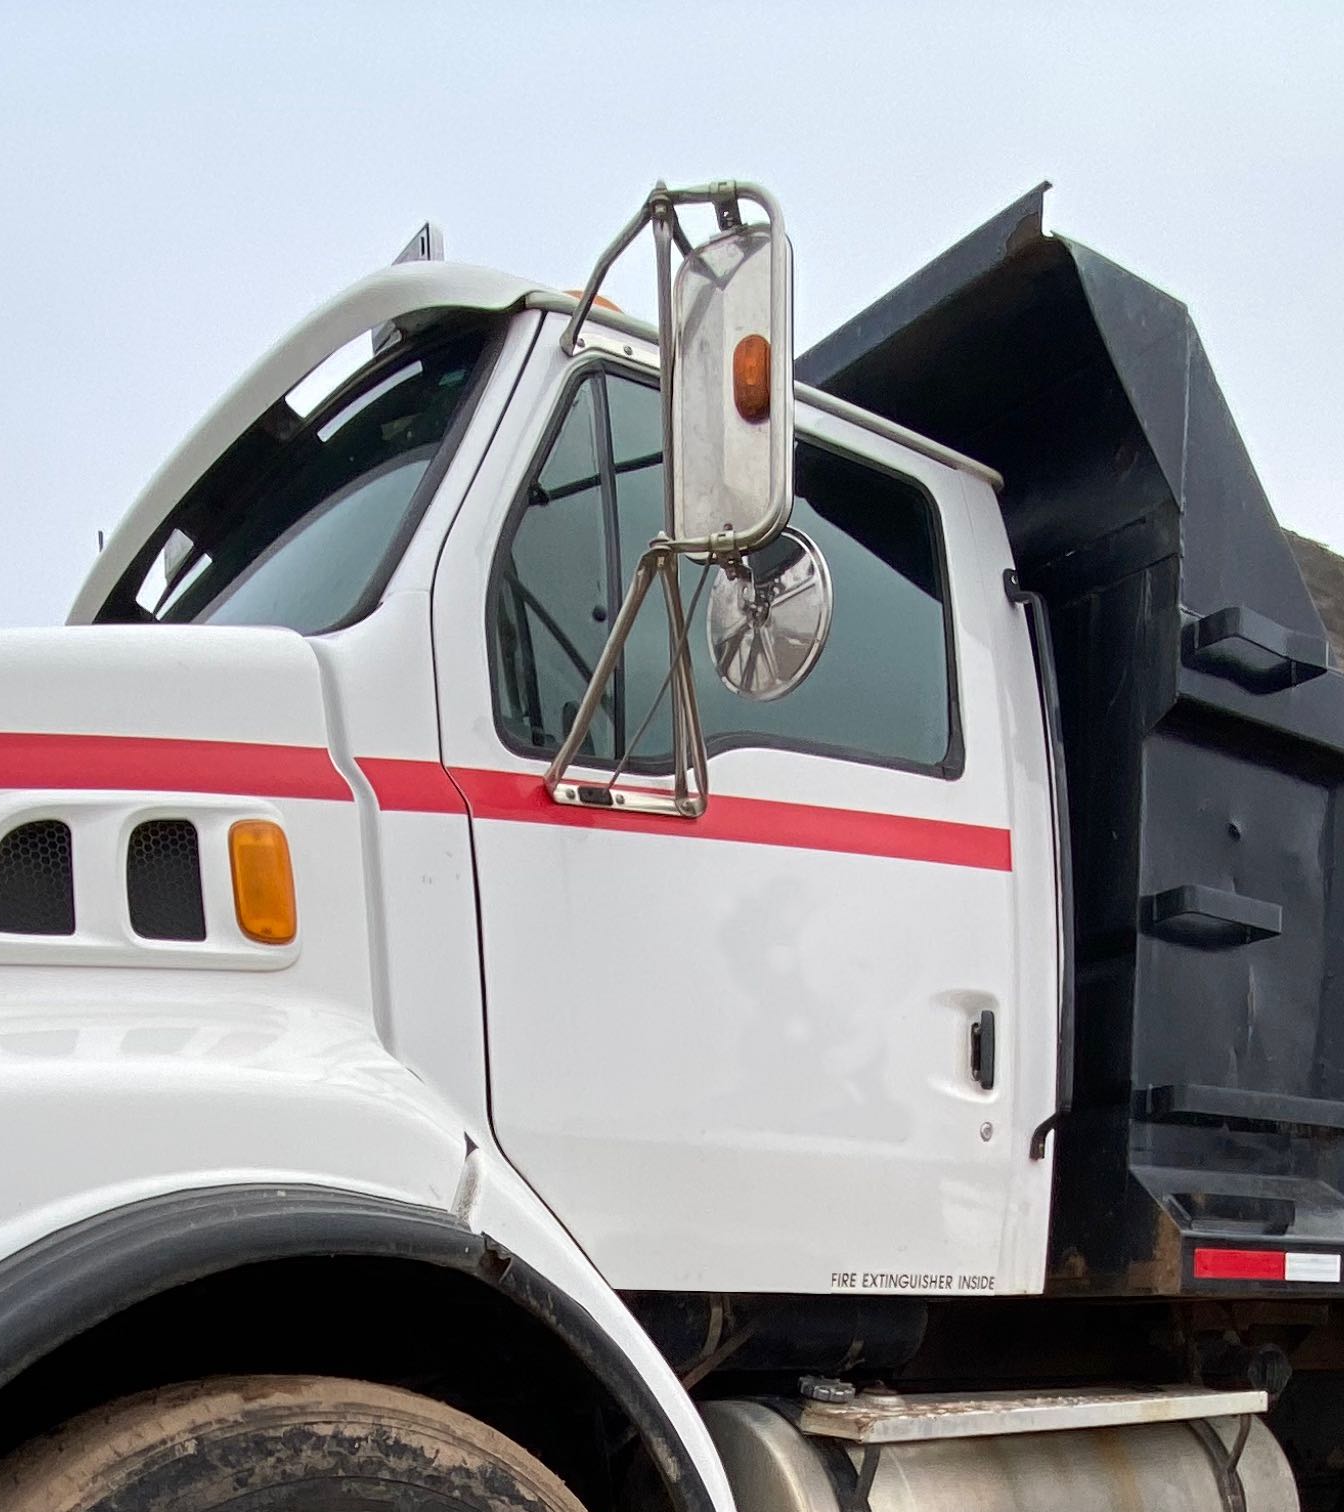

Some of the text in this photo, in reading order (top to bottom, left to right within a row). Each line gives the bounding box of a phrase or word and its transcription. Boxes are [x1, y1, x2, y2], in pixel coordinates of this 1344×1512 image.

[831, 1272, 995, 1290] FIRE EXTINGUISHER INSIDE
